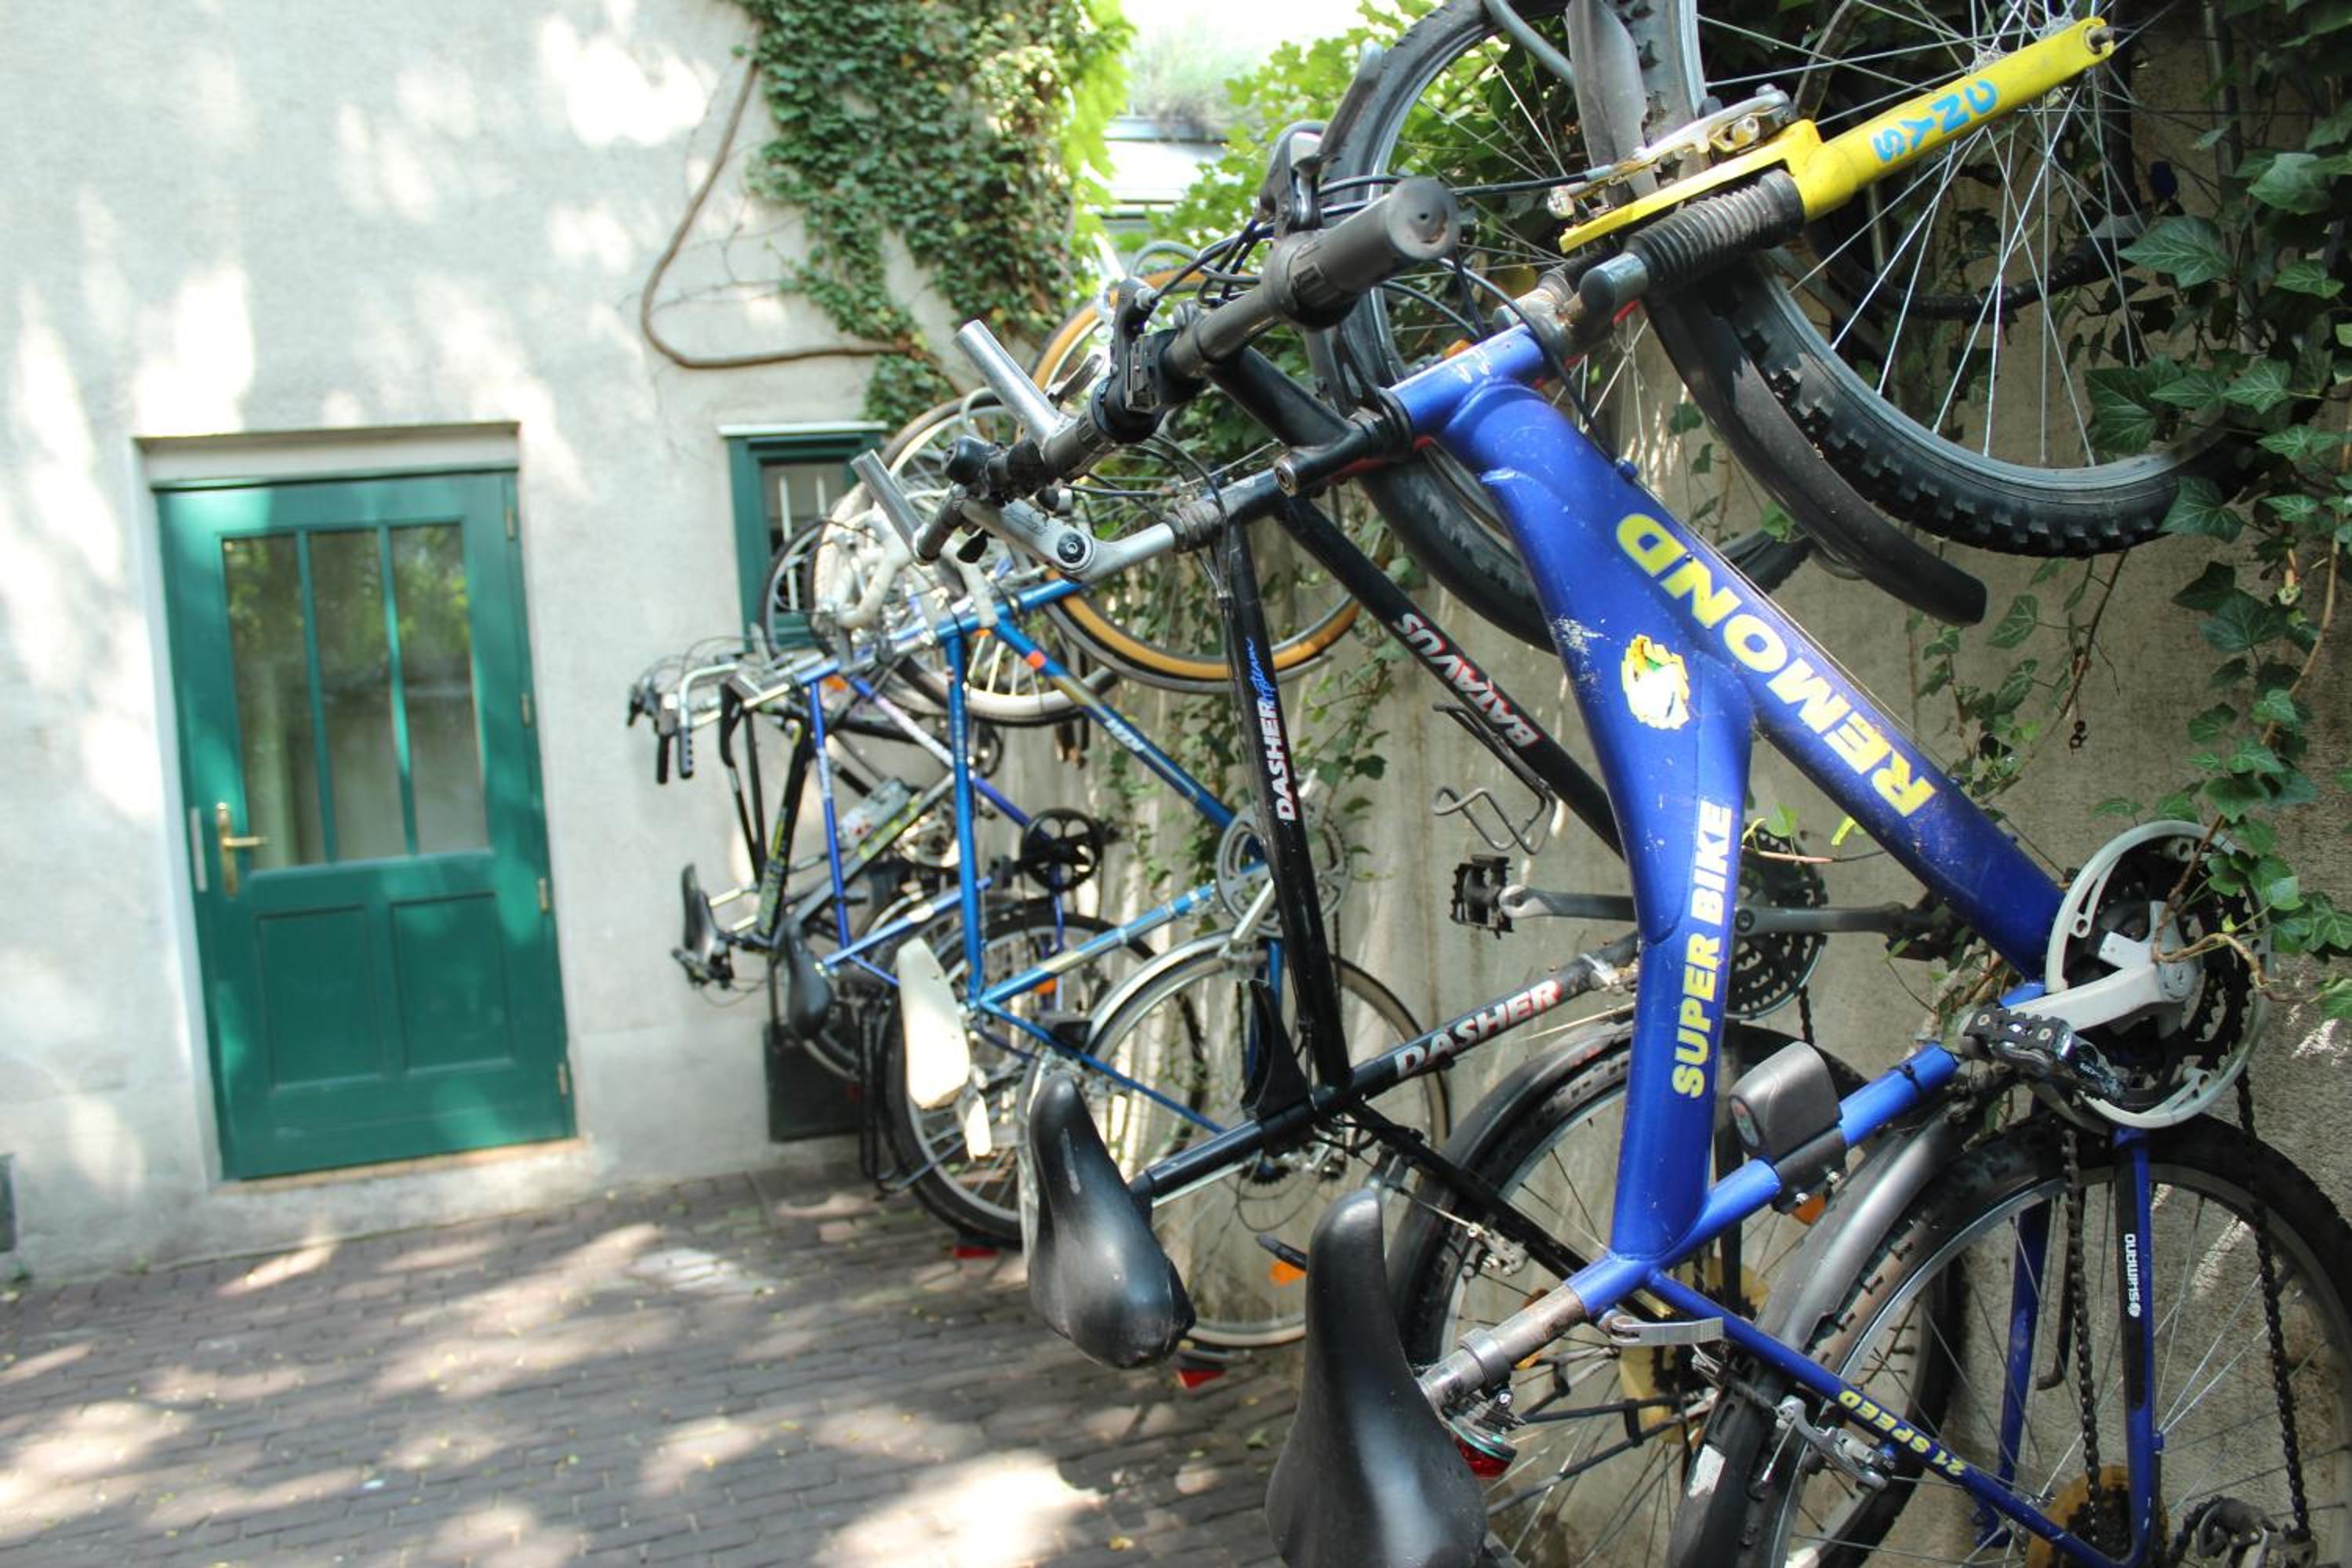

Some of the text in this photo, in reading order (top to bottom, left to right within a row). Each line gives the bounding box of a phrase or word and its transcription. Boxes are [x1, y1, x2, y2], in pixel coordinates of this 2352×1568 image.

[1873, 79, 1997, 162] SYNC
[1392, 613, 1541, 747] BATAVUS
[1616, 514, 1937, 817] REMOND
[1255, 694, 1296, 822] DASHER
[1672, 799, 1733, 1098] SUPER BIKE
[1394, 978, 1563, 1079] DASHER
[2125, 1233, 2139, 1303] SHIMANO
[1838, 1388, 1966, 1476] 21 SPEED
